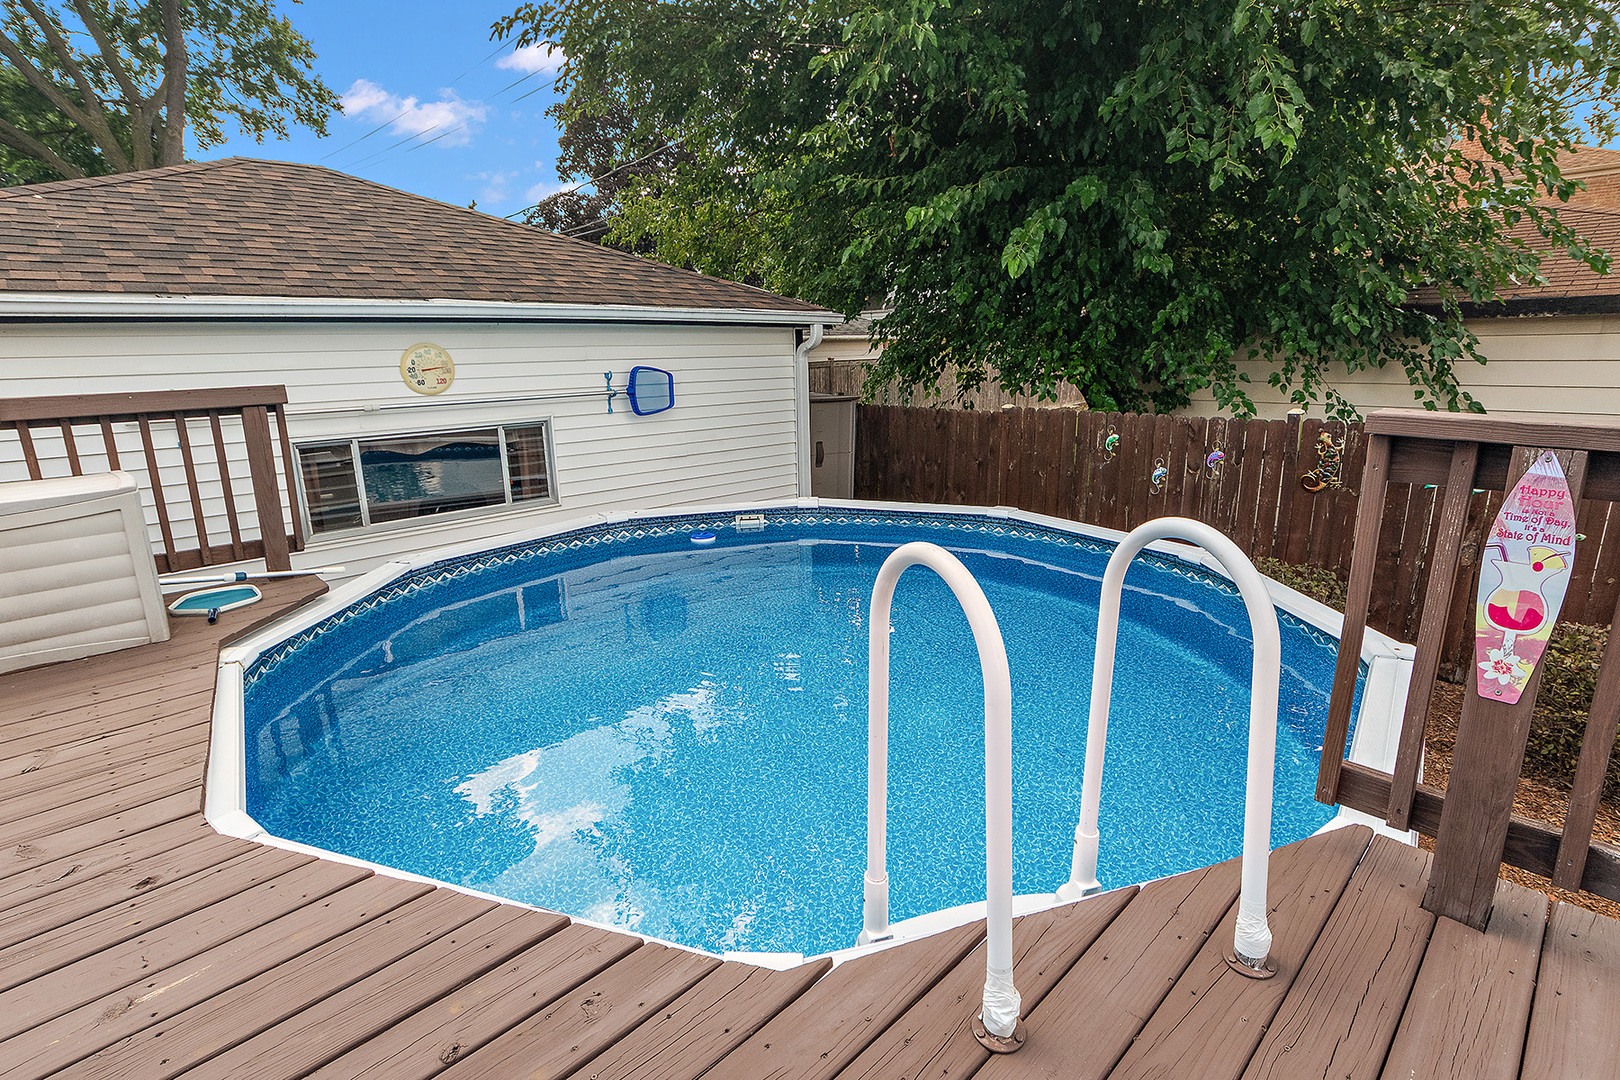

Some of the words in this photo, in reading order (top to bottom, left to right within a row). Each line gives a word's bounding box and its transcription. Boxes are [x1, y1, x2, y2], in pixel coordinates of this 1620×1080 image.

[1519, 485, 1566, 500] Happy
[1518, 495, 1564, 510] Hour
[1503, 511, 1529, 523] Time
[1531, 516, 1544, 526] of
[1496, 528, 1524, 541] State
[1525, 532, 1539, 544] of
[1540, 532, 1571, 546] Mind
